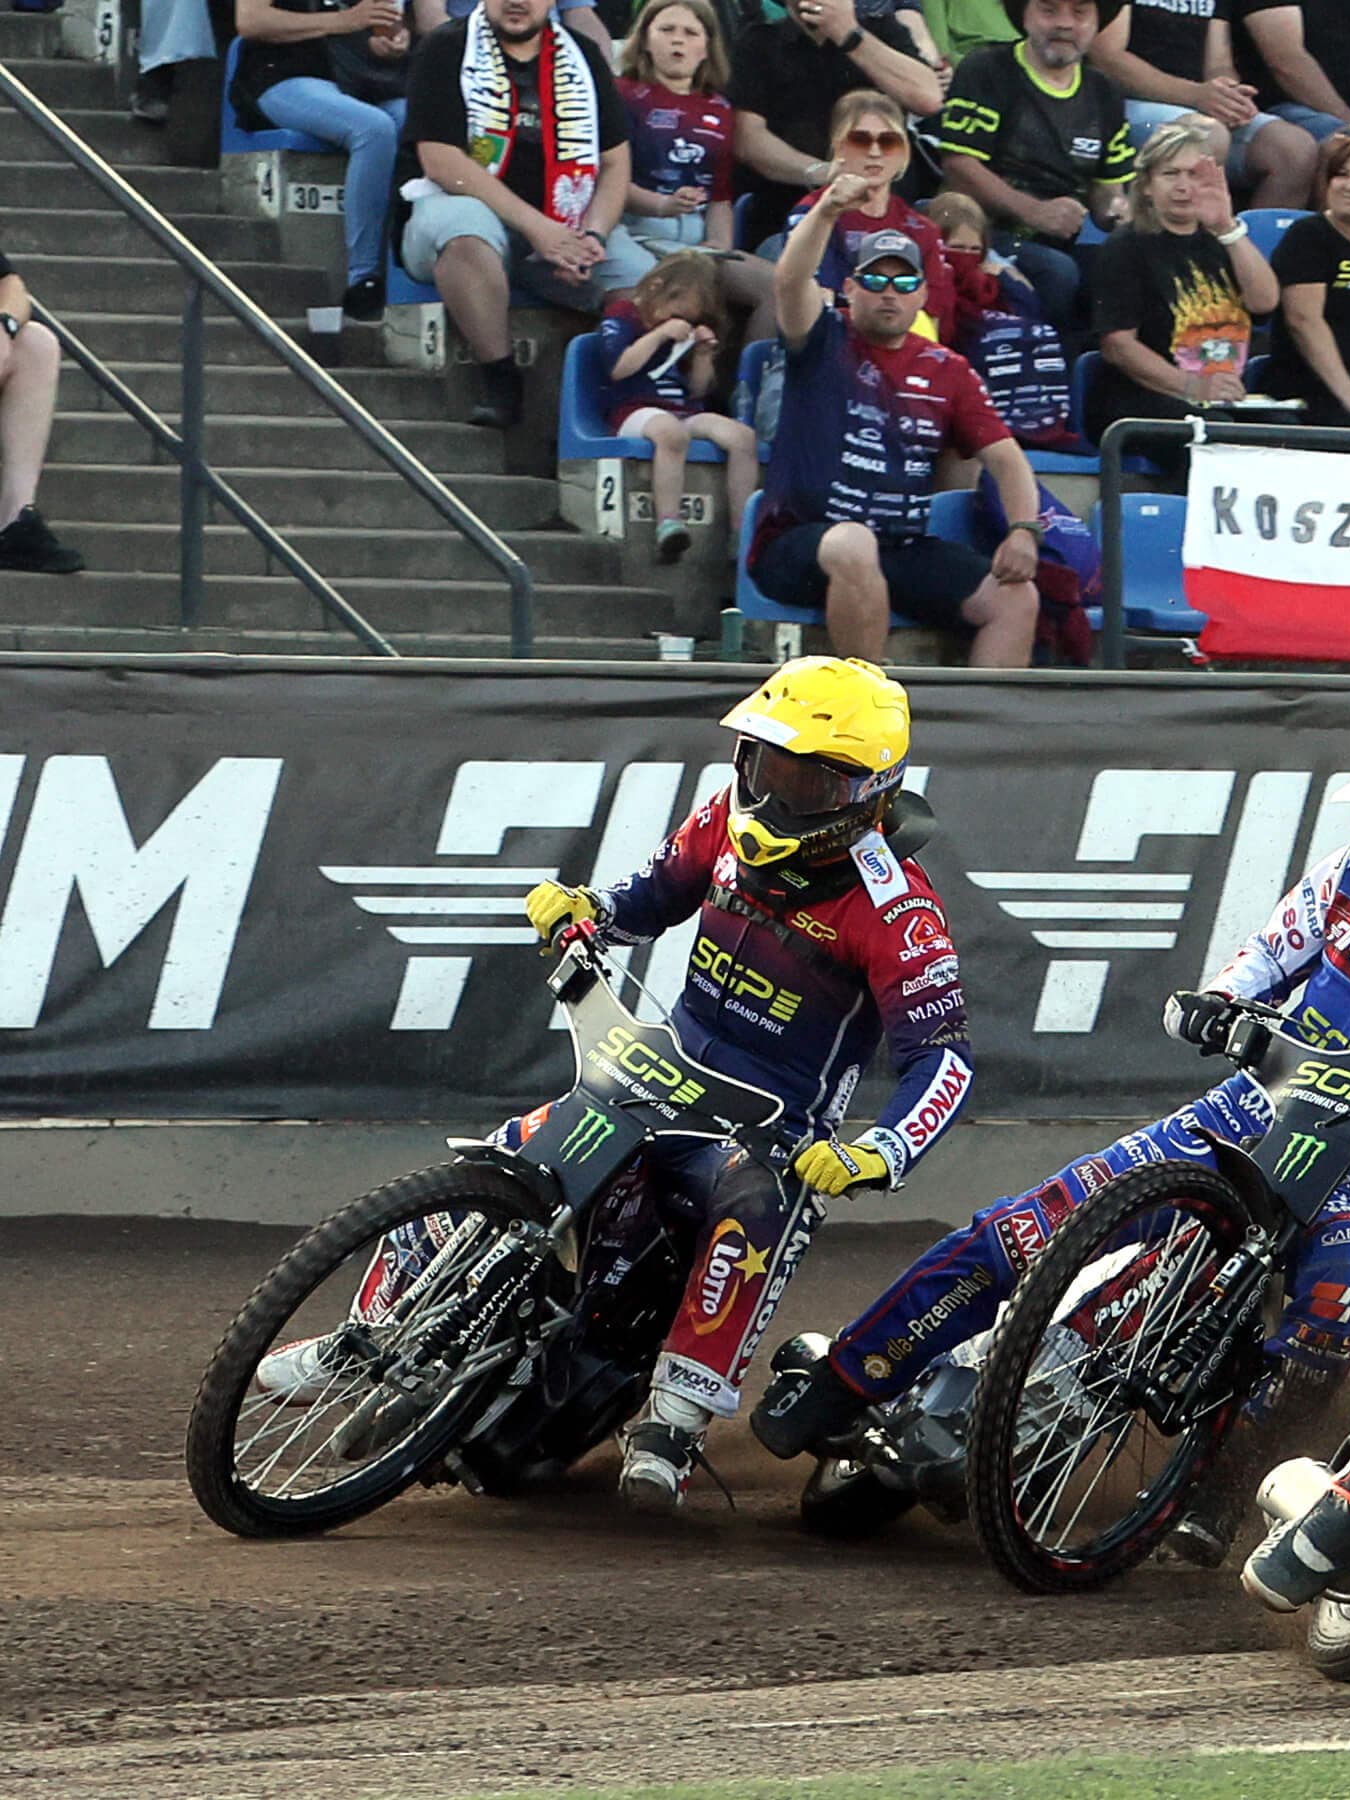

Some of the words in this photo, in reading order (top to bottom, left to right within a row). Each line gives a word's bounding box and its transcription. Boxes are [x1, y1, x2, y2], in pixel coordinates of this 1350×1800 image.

[99, 13, 113, 46] 5
[260, 168, 274, 203] 4
[424, 319, 438, 356] 3
[601, 475, 615, 511] 2
[0, 753, 285, 1030] M
[317, 760, 932, 1031] FI
[723, 998, 760, 1025] GRAND
[757, 1015, 786, 1037] PRIX
[597, 1025, 684, 1088] SGP
[595, 1056, 634, 1089] SPEEDWAY
[655, 1102, 681, 1122] PRIX
[905, 1060, 968, 1148] SONAX
[1290, 1087, 1336, 1110] SPEEDWAY
[702, 1242, 742, 1316] LOTTO
